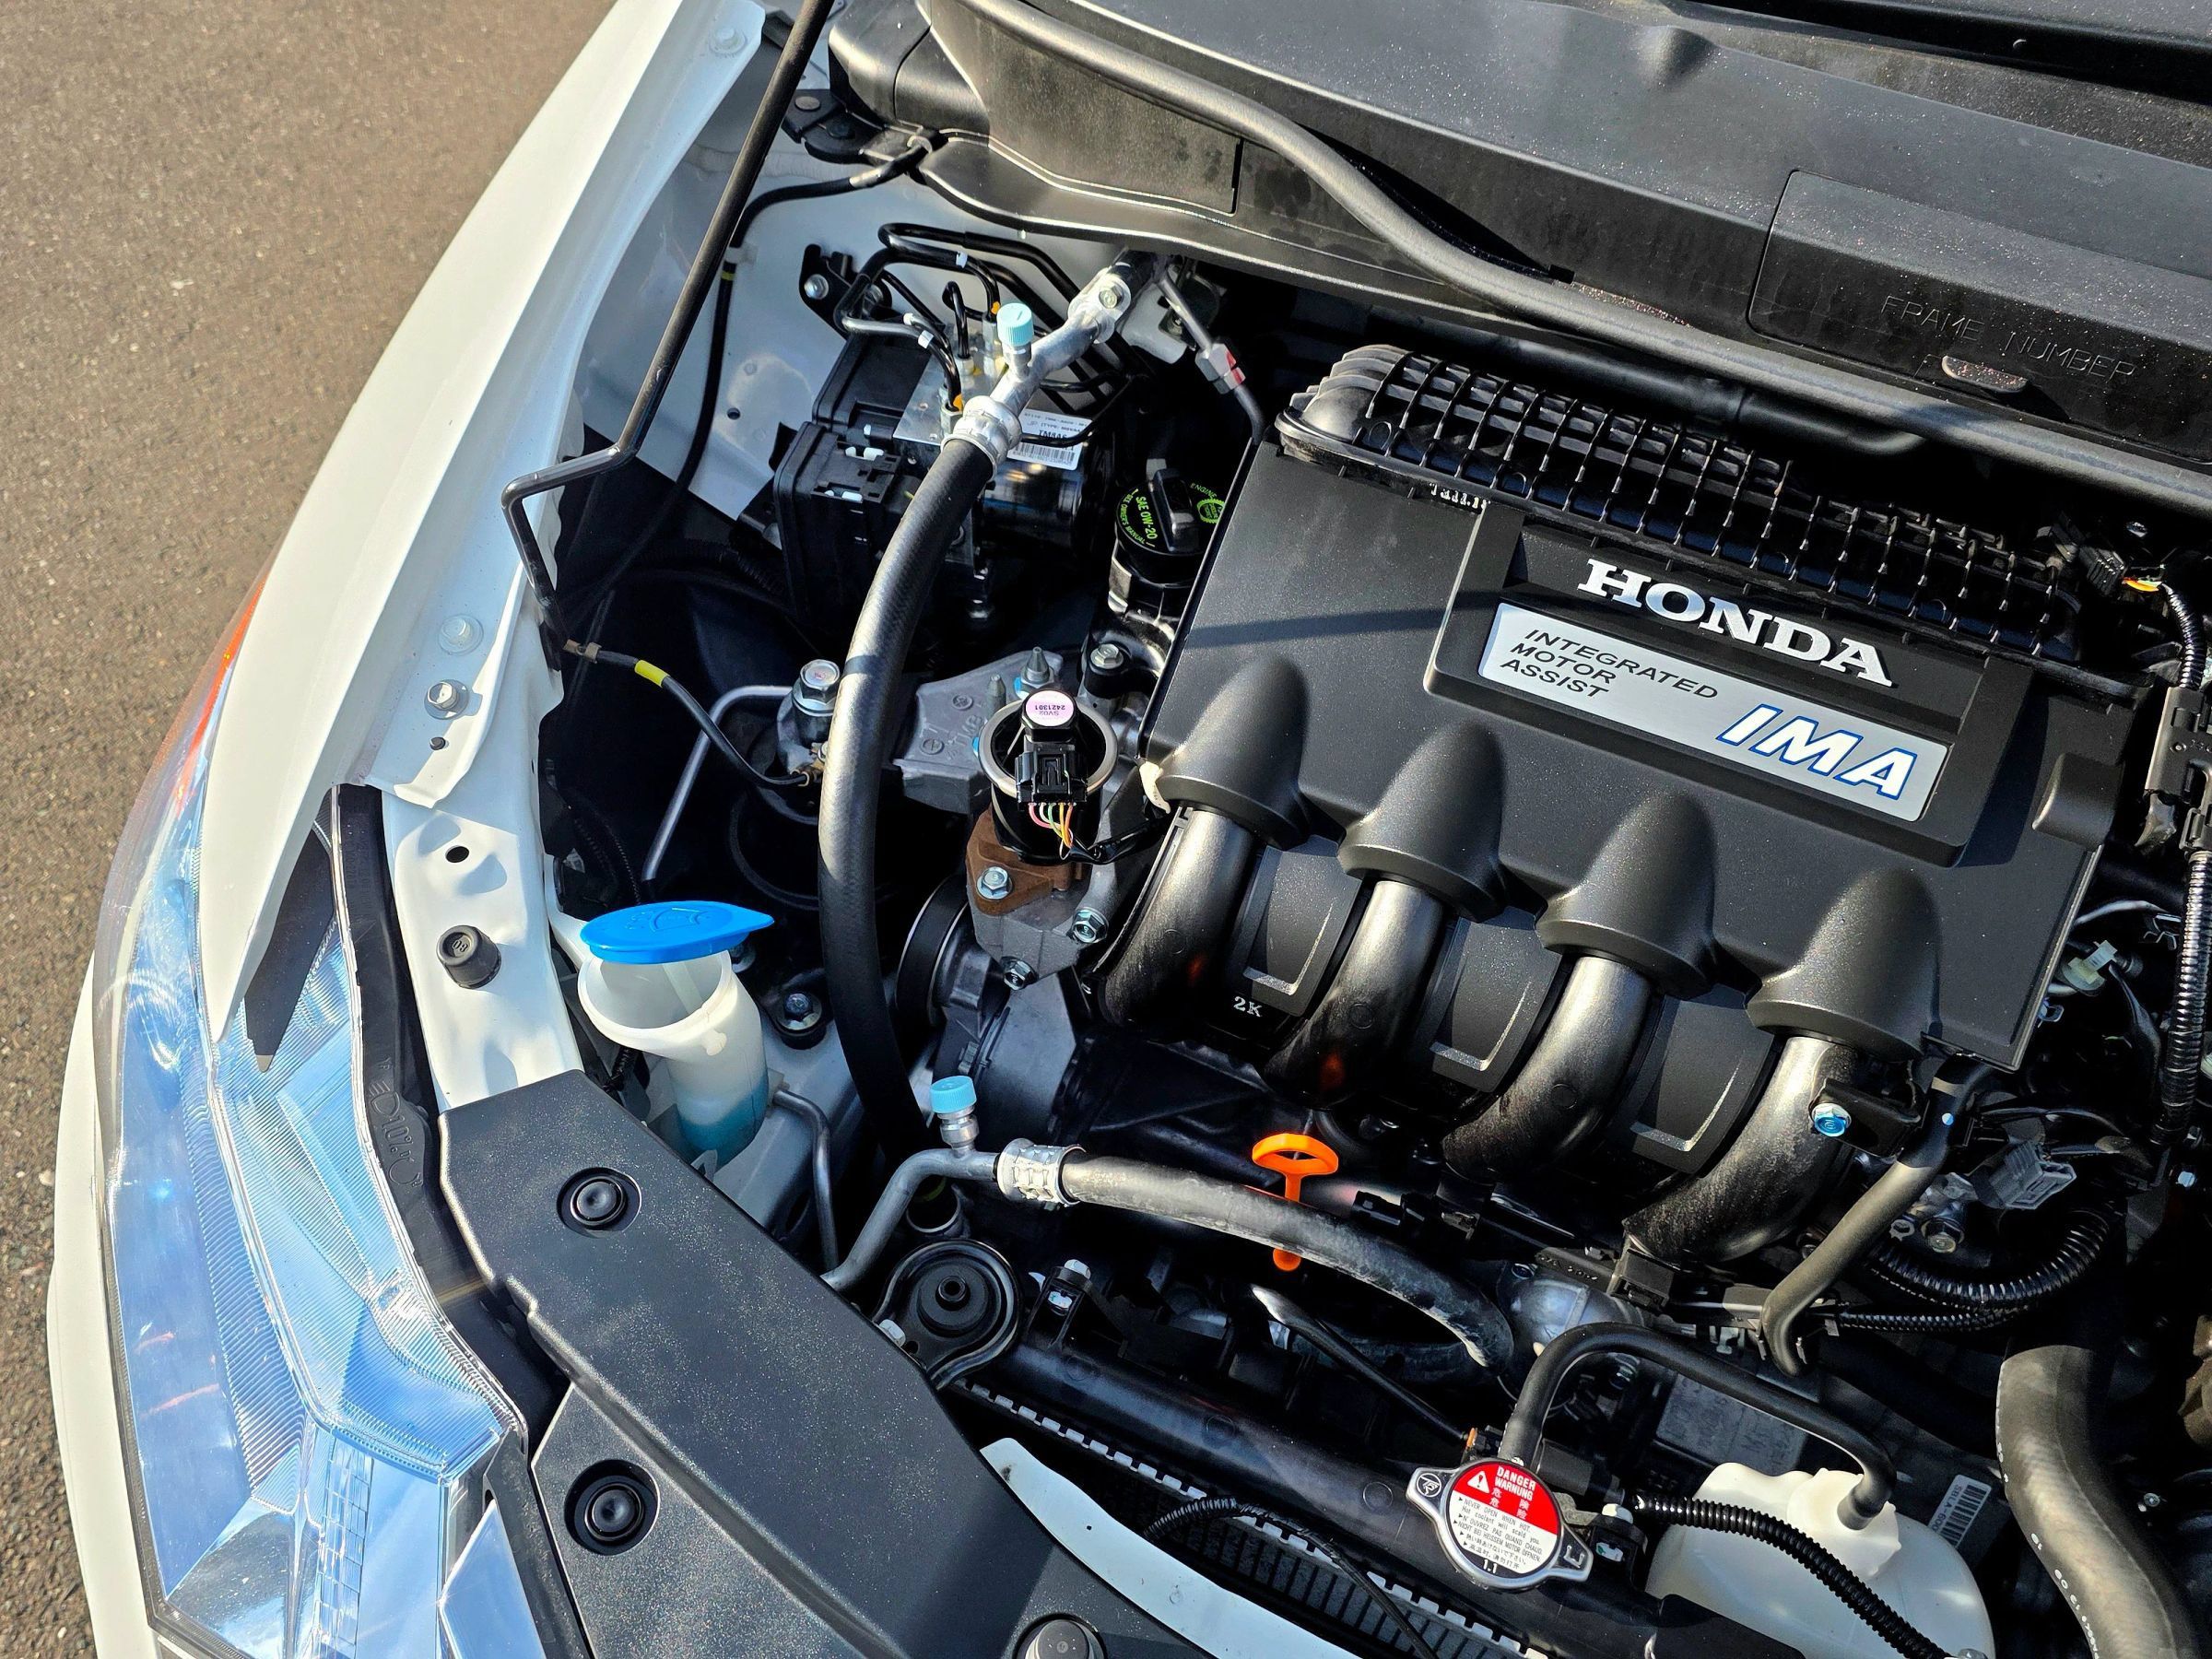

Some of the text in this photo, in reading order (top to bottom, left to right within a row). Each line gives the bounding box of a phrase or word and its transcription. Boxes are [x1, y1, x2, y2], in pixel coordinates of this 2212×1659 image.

[1881, 295, 2137, 383] FRAME NUMBER
[1135, 496, 1149, 511] SAE
[1190, 482, 1218, 499] ENGINE
[1125, 525, 1145, 545] MANUAL
[1576, 558, 1894, 688] HONDA
[1510, 642, 1617, 685] MOTOR
[1524, 629, 1719, 700] INTEGRATED
[1500, 658, 1609, 699] ASSIST
[1715, 703, 1918, 801] IMA
[1233, 995, 1263, 1018] 2K
[1494, 1477, 1533, 1501] WARNUNG
[1497, 1465, 1535, 1491] DANGER
[1464, 1500, 1480, 1512] NEVER
[1484, 1507, 1498, 1518] OPEN
[1501, 1513, 1516, 1525] WHEN
[1475, 1512, 1494, 1524] coolant
[1498, 1520, 1508, 1530] will
[1512, 1526, 1527, 1540] scald
[1458, 1522, 1472, 1535] NICHT
[1473, 1526, 1483, 1537] BEI
[1483, 1530, 1504, 1547] HEISSEM
[1505, 1539, 1521, 1554] MOTOR
[1470, 1517, 1488, 1531] OUVREZ
[1492, 1525, 1502, 1536] PAS
[1504, 1532, 1523, 1546] QUAND
[1482, 1559, 1498, 1574] 1.1
